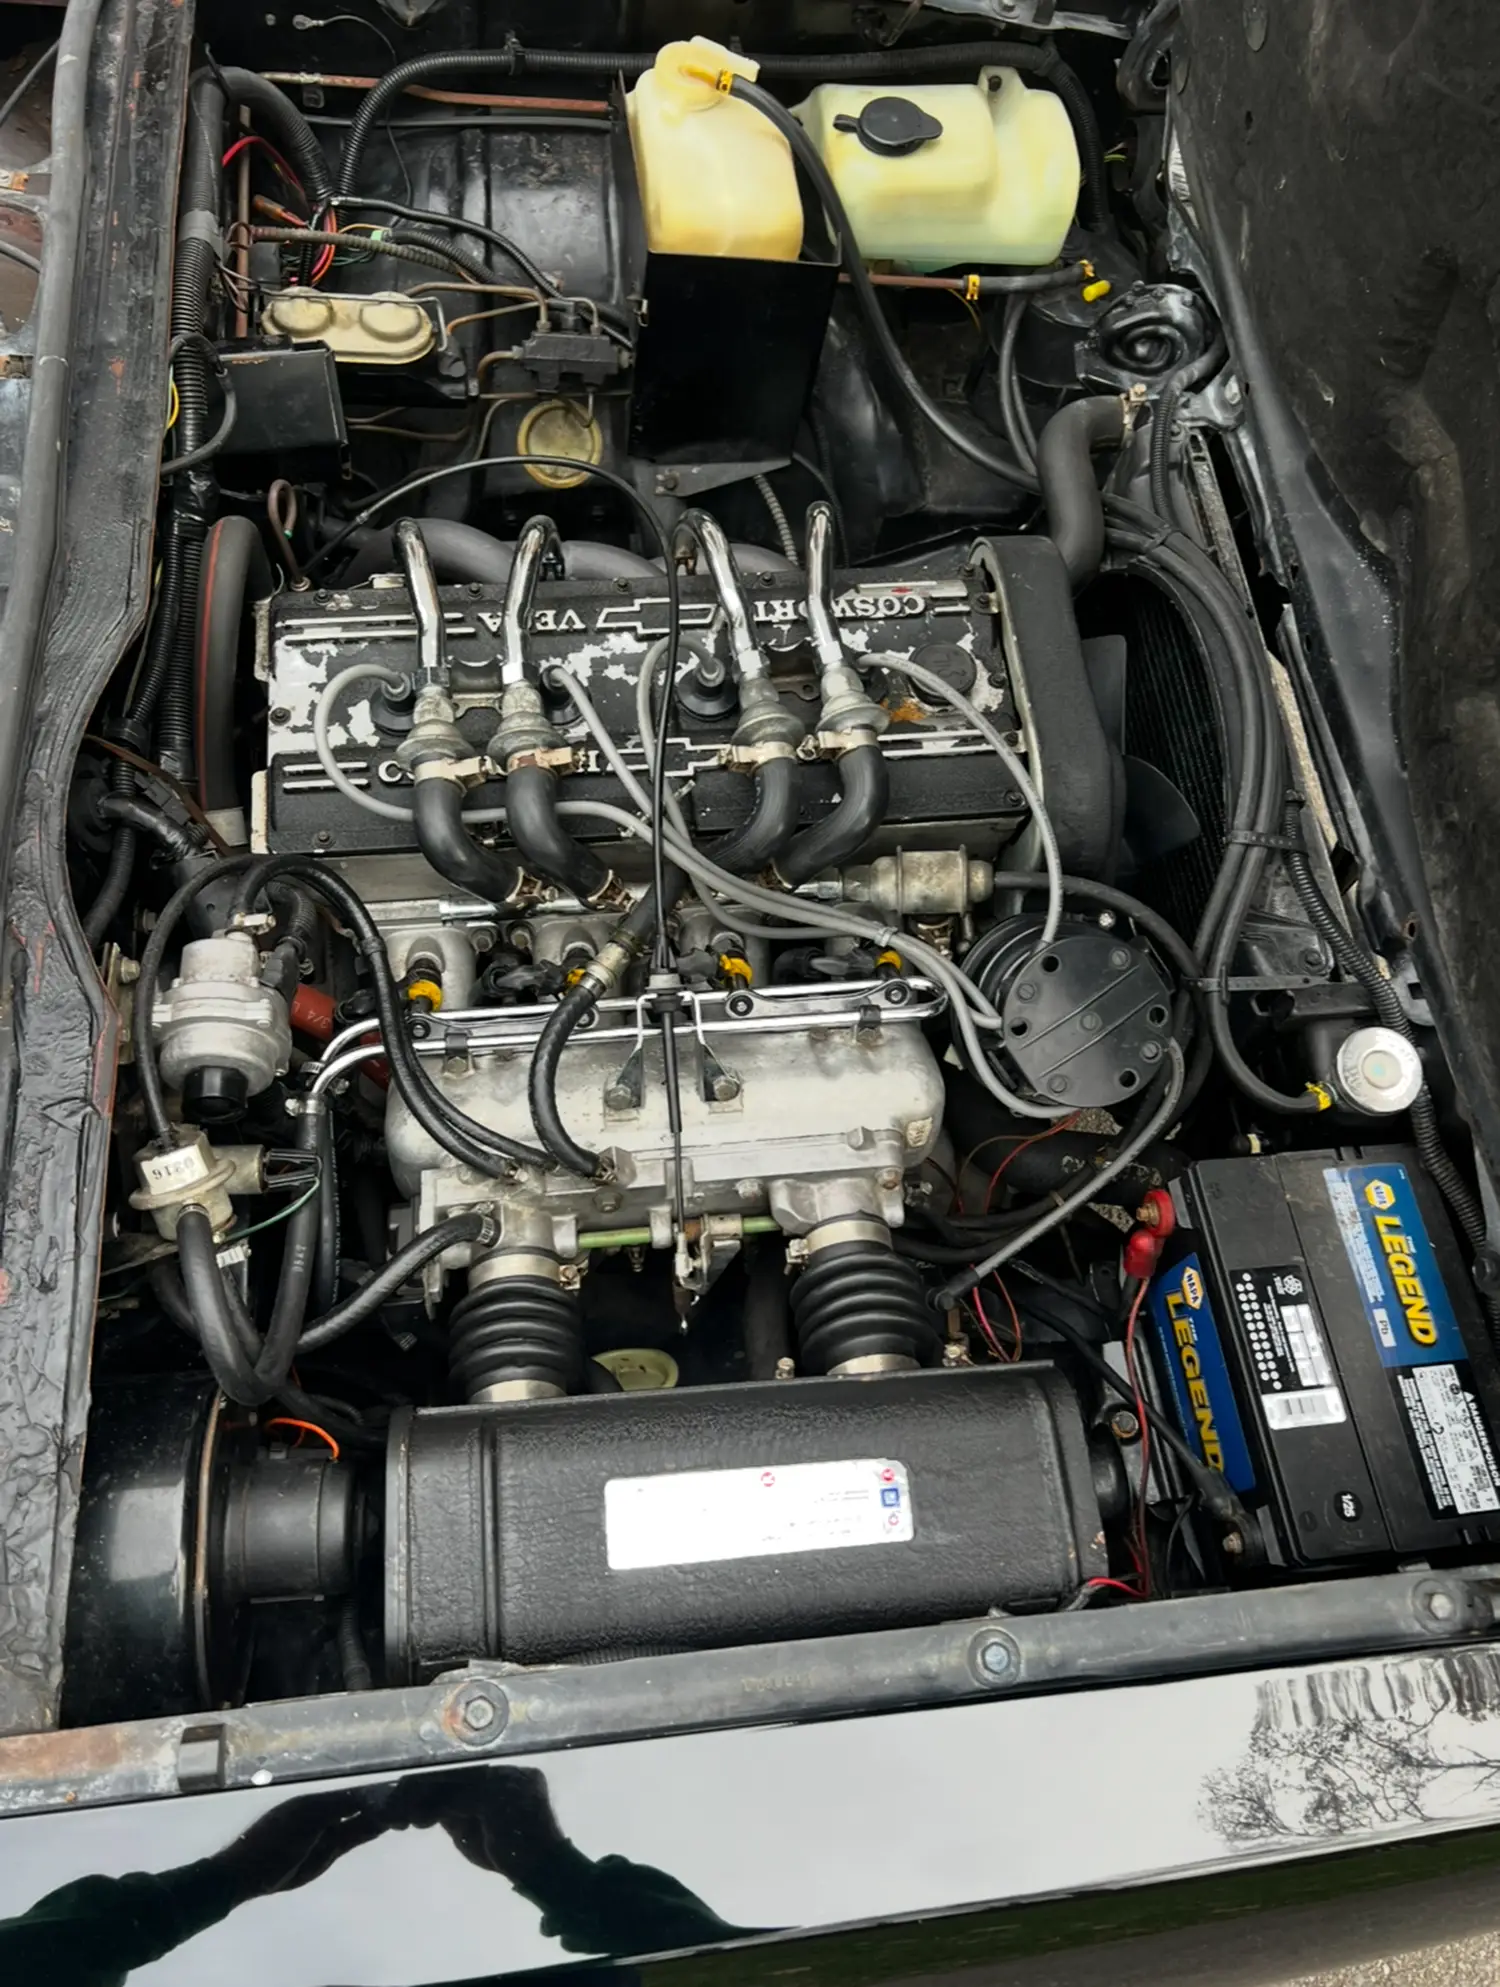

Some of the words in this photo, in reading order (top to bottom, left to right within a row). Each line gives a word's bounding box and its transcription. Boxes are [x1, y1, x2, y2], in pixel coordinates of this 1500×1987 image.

[478, 607, 586, 632] VEA
[752, 595, 926, 622] COSWRT
[1186, 1273, 1199, 1303] NAPA
[1374, 1215, 1438, 1346] LEGEND
[1188, 1317, 1198, 1341] THE
[1379, 1319, 1389, 1336] Pb
[1165, 1290, 1225, 1474] LEGEND
